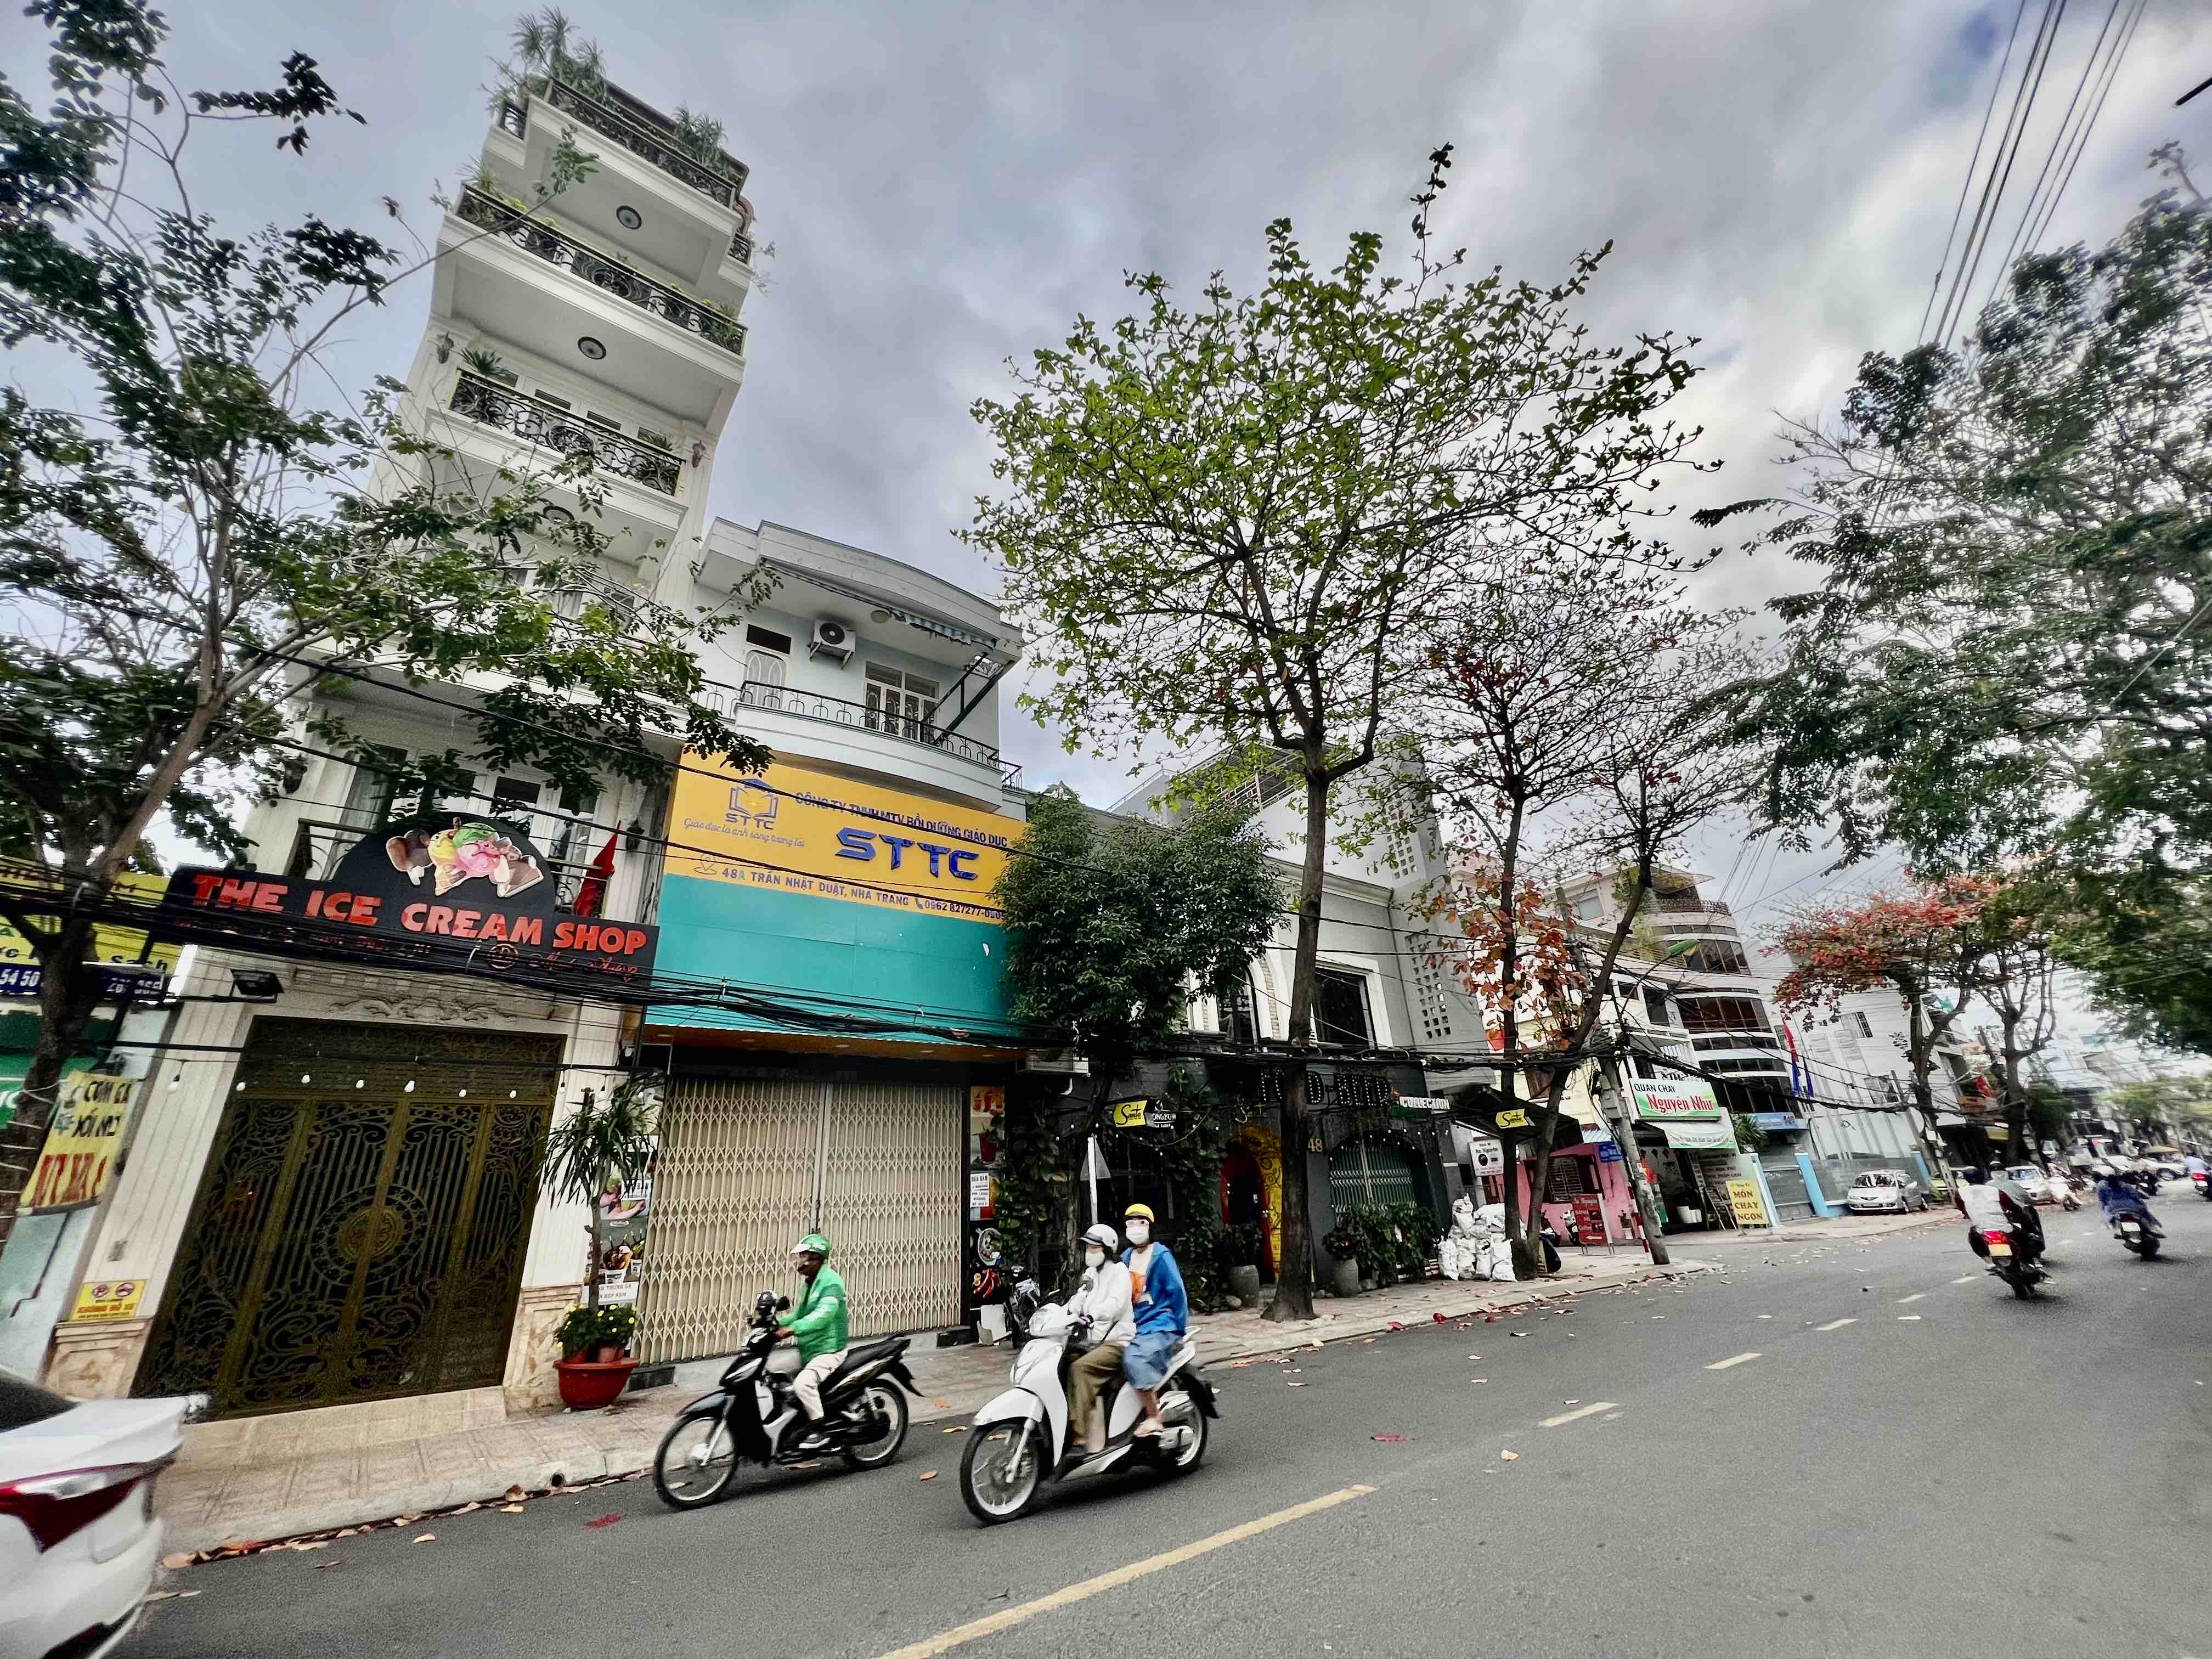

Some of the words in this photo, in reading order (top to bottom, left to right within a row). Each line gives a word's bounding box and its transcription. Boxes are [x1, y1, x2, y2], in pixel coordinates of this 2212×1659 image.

[834, 827, 979, 880] STTC
[193, 874, 289, 912] THE
[303, 889, 381, 926] ICE
[400, 902, 543, 945] CREAM
[552, 921, 647, 955] SHOP
[851, 888, 872, 901] NHA
[876, 893, 909, 906] TRANG
[1658, 1085, 1676, 1093] CHAY
